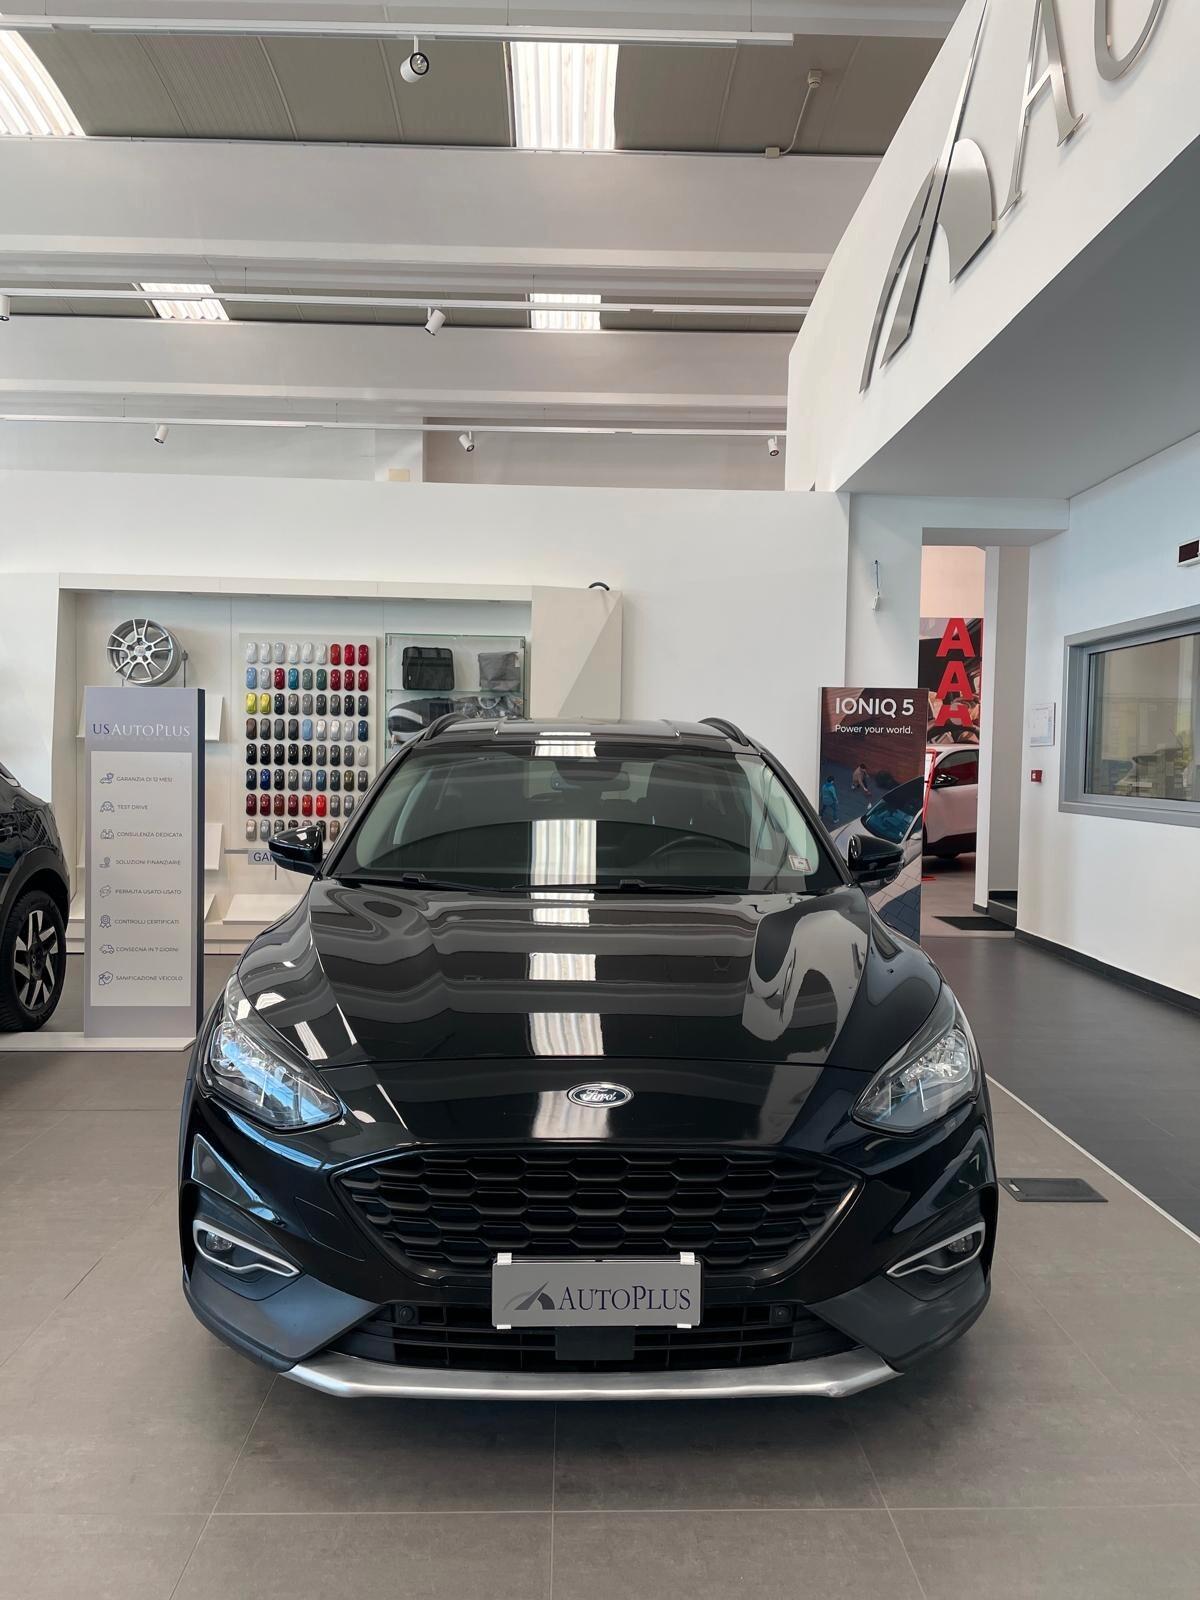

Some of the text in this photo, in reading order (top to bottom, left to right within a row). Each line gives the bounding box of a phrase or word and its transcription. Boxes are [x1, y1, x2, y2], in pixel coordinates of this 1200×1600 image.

[835, 697, 915, 718] IONIQ 5
[835, 724, 913, 735] Power your world.
